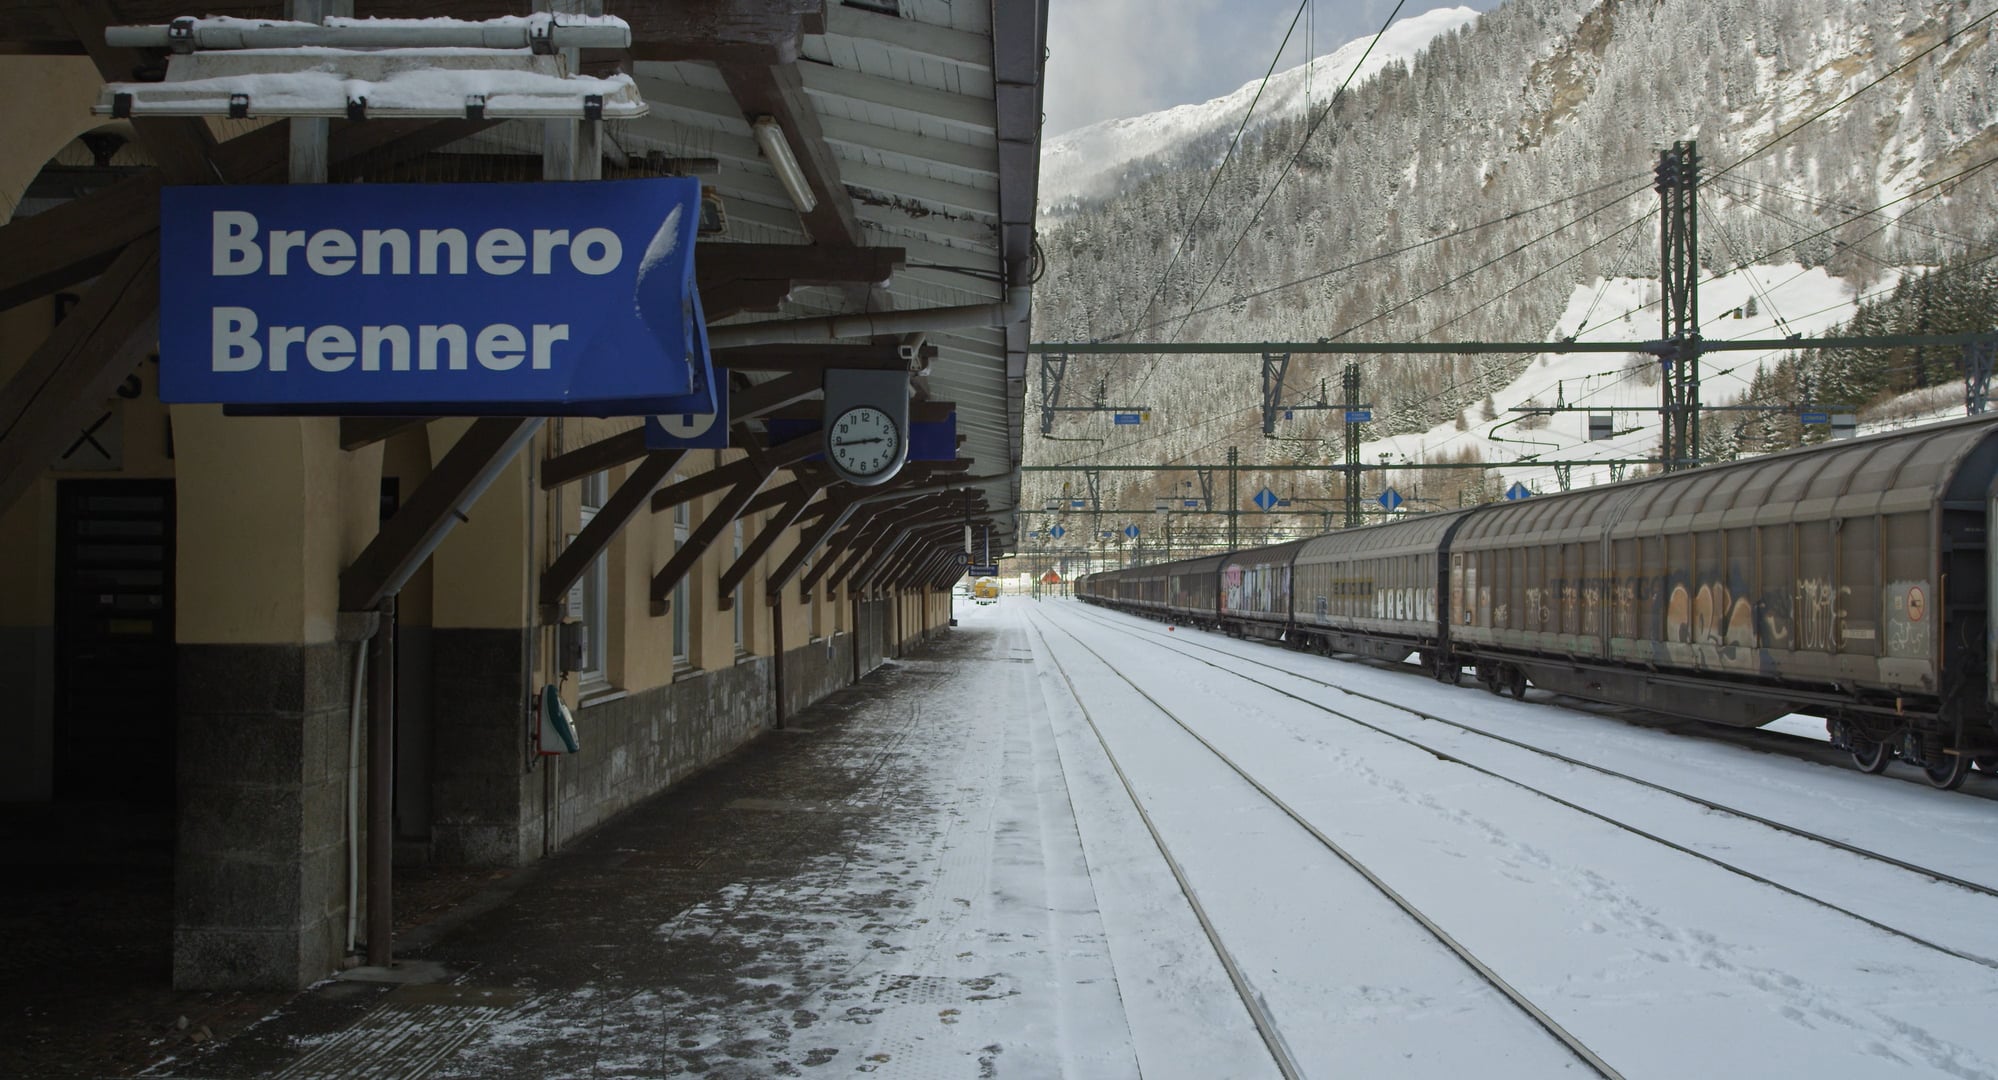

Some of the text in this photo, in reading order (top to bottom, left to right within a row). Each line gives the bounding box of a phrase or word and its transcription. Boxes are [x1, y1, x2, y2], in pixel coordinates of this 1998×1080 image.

[211, 210, 623, 277] Brennero
[211, 305, 570, 373] Brenner
[851, 415, 857, 425] 11
[861, 412, 870, 422] 12
[876, 416, 880, 426] 1
[840, 424, 848, 434] 10
[883, 425, 889, 434] 2
[887, 438, 893, 447] 3
[840, 448, 846, 458] 8
[882, 449, 888, 459] 4
[849, 457, 855, 467] 7
[860, 461, 866, 471] 6
[873, 458, 879, 468] 5
